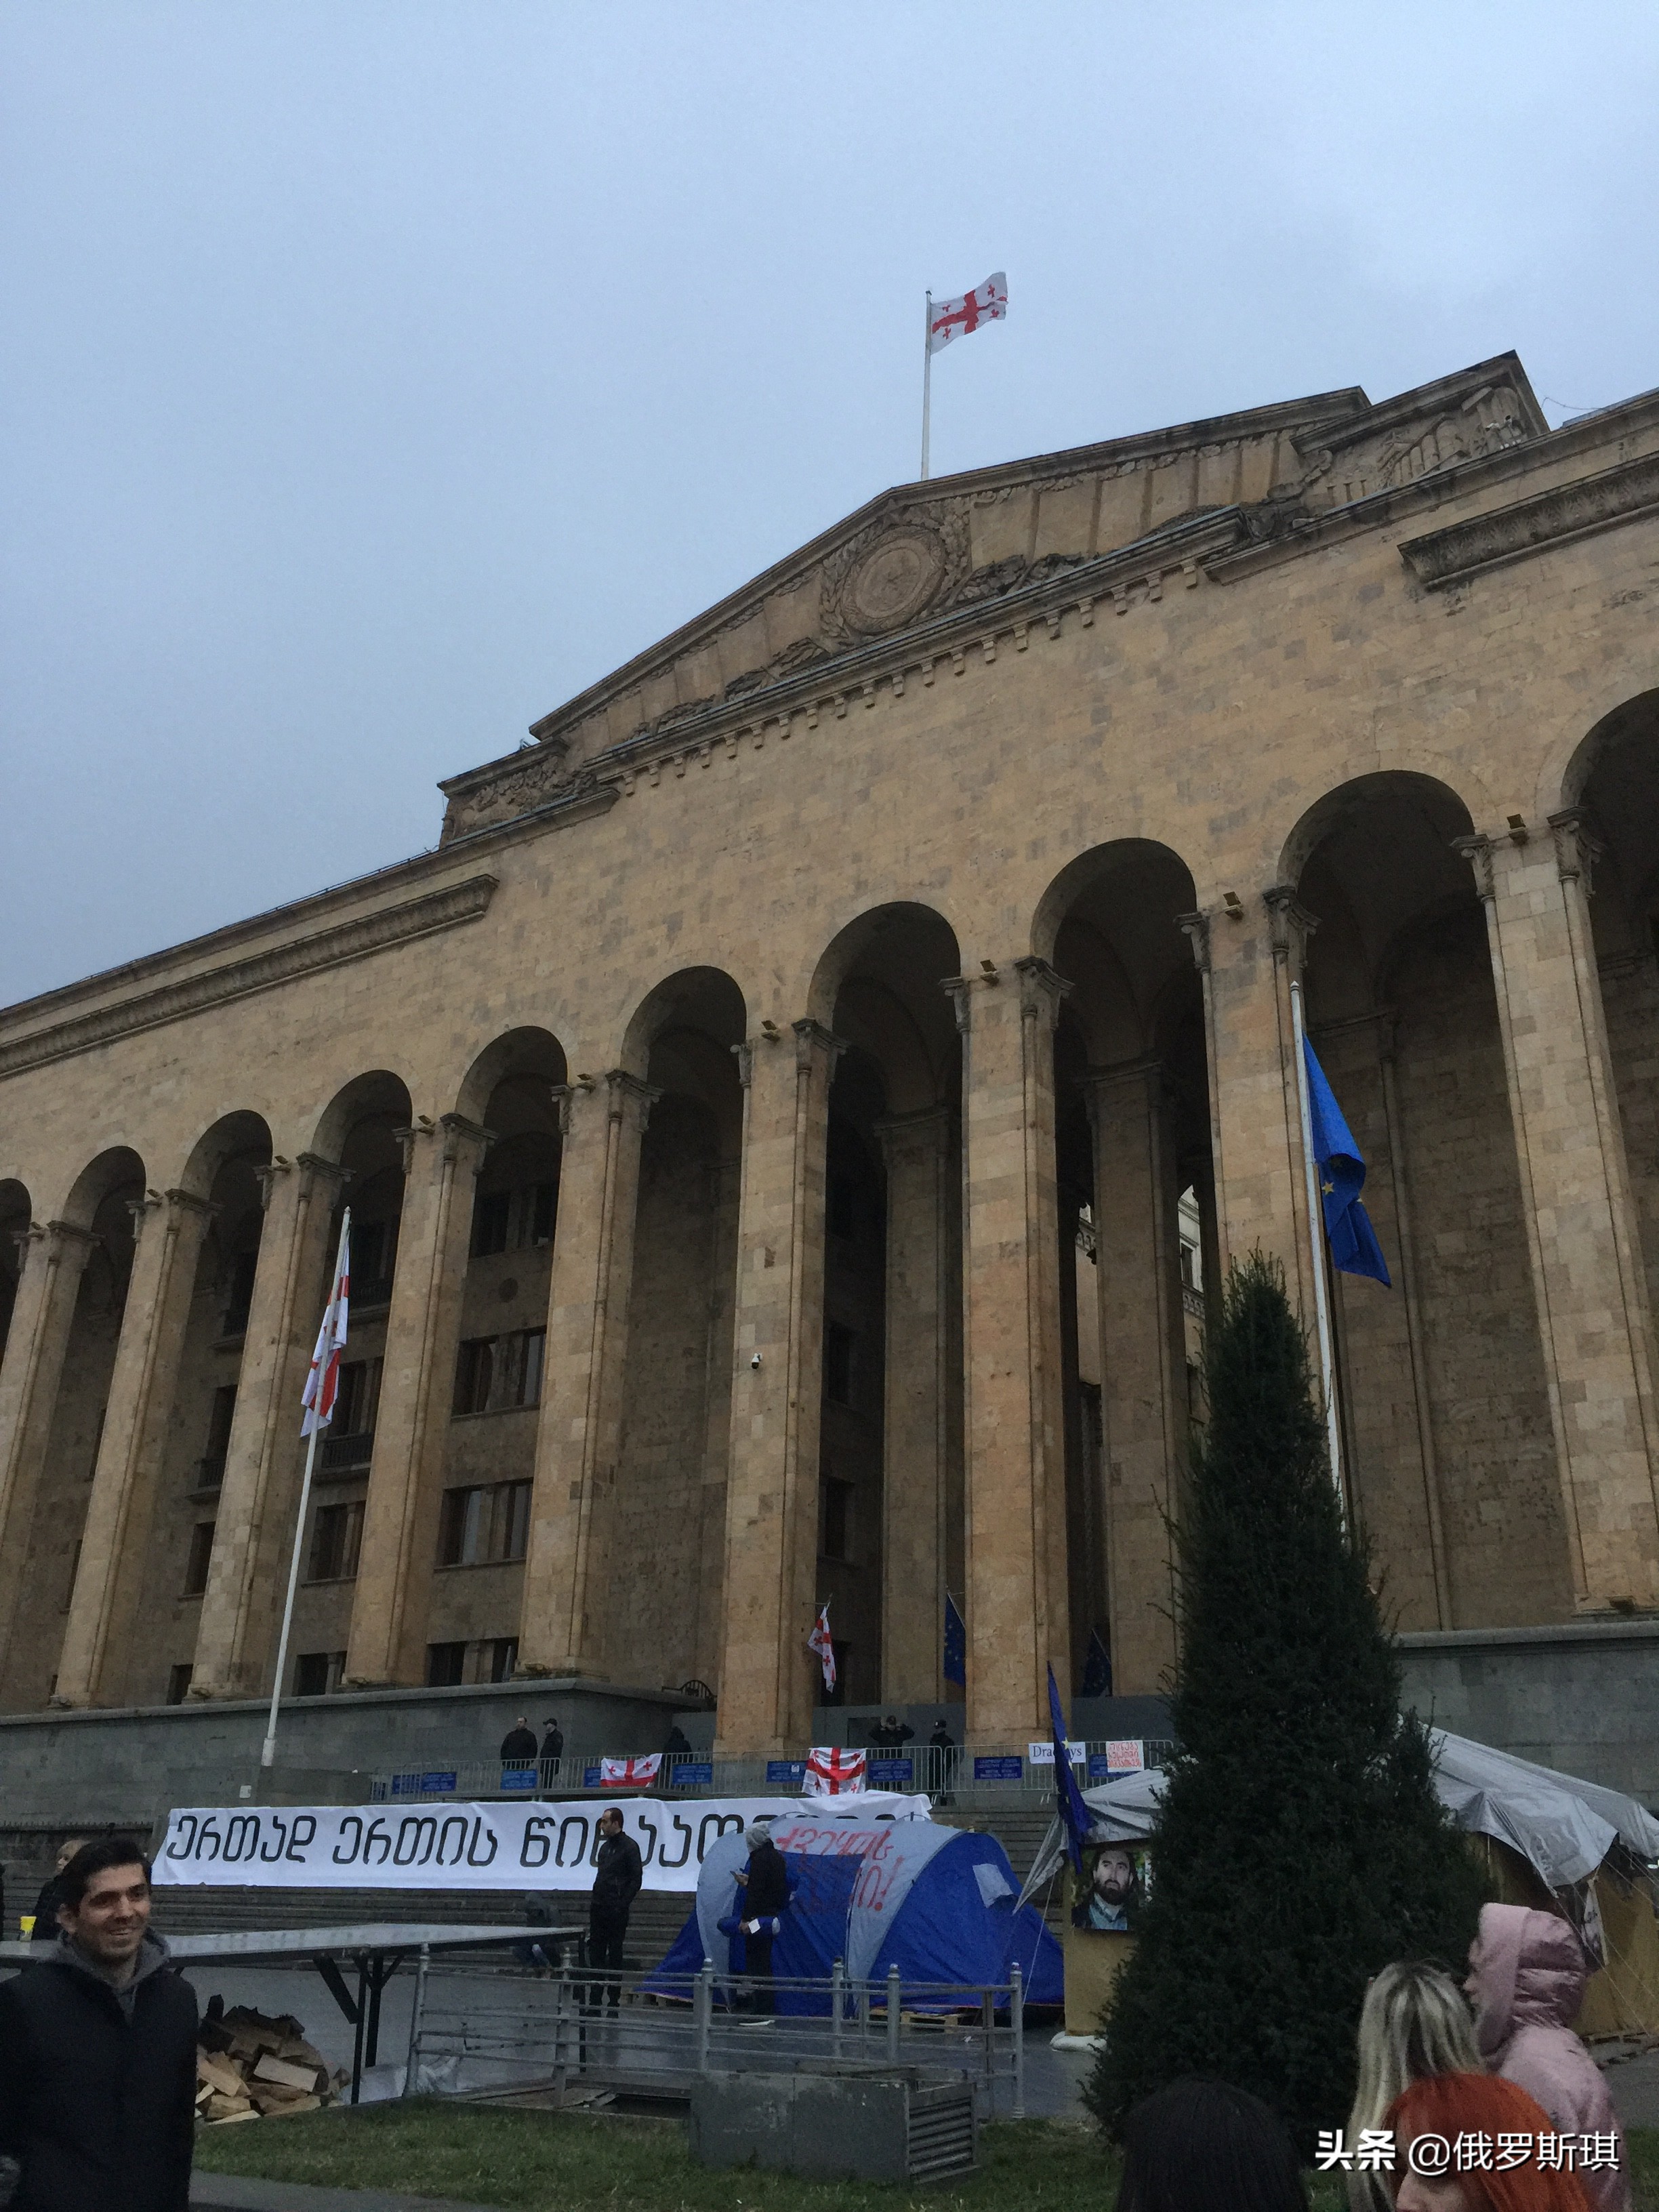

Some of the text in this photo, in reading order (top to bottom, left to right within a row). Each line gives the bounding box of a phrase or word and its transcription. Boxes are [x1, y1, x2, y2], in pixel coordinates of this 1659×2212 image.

[1033, 1745, 1082, 1760] Drays
[166, 1814, 897, 1868] ერთად ერთის წიააღ
